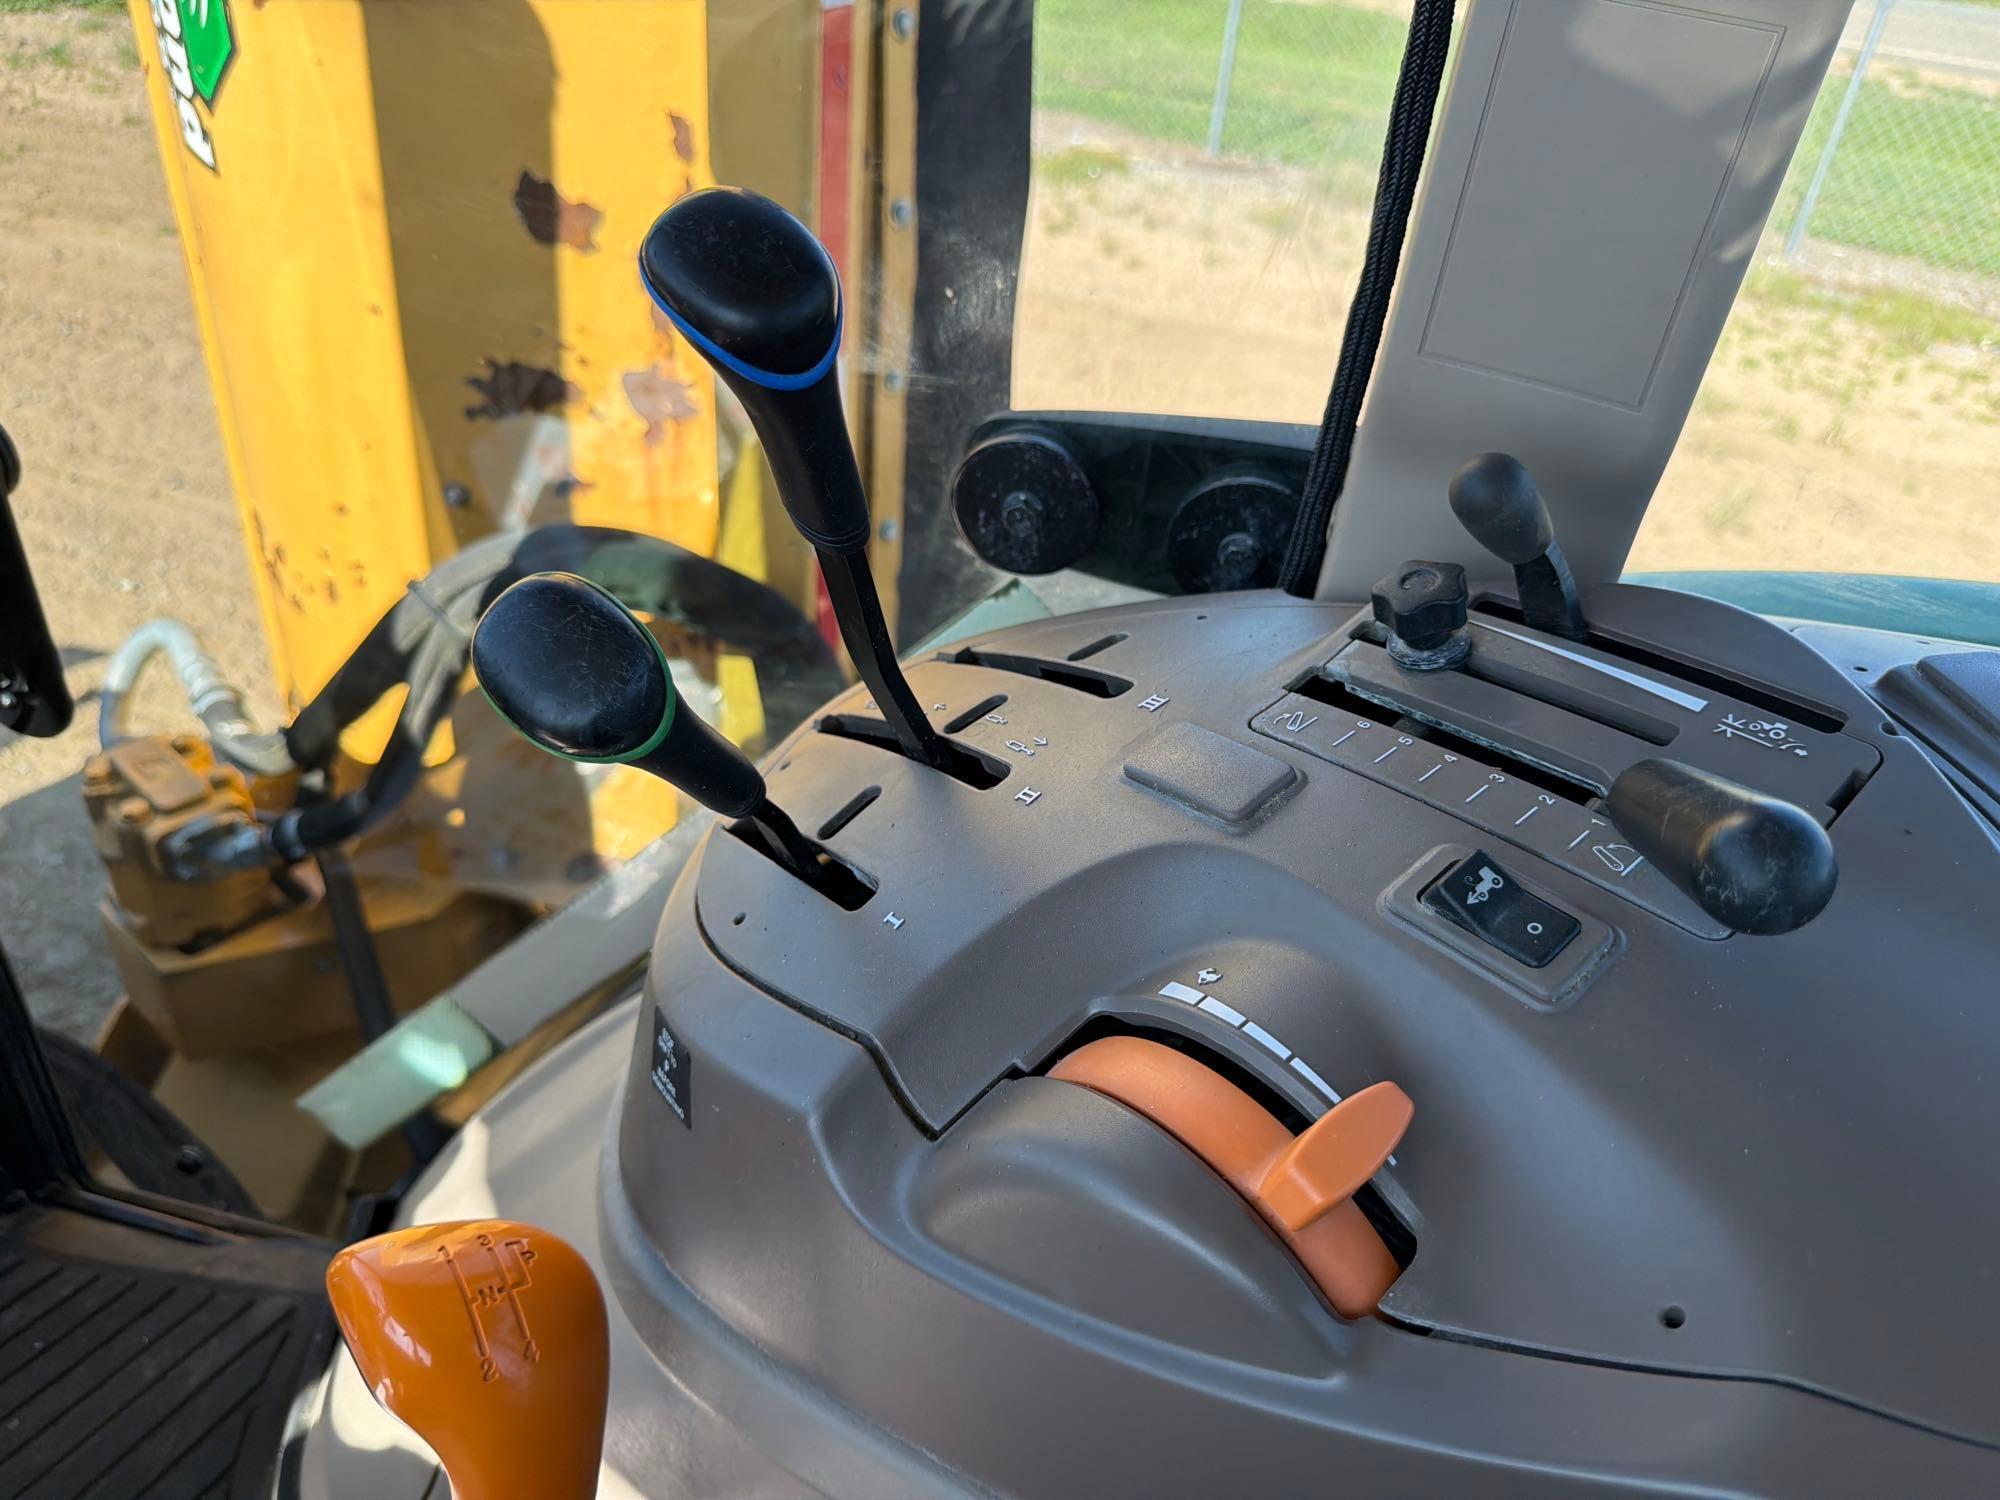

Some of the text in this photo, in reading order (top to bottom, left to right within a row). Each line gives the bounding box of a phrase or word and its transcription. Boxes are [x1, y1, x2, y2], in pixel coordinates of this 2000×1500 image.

[1356, 720, 1371, 729] 6
[1398, 736, 1413, 746] 5
[1443, 753, 1458, 763] 4
[1488, 773, 1505, 783] 3
[1538, 794, 1555, 805] 2
[1591, 818, 1606, 826] 1
[437, 1244, 454, 1259] 1
[476, 1233, 495, 1248] 3
[480, 1357, 499, 1383] 2
